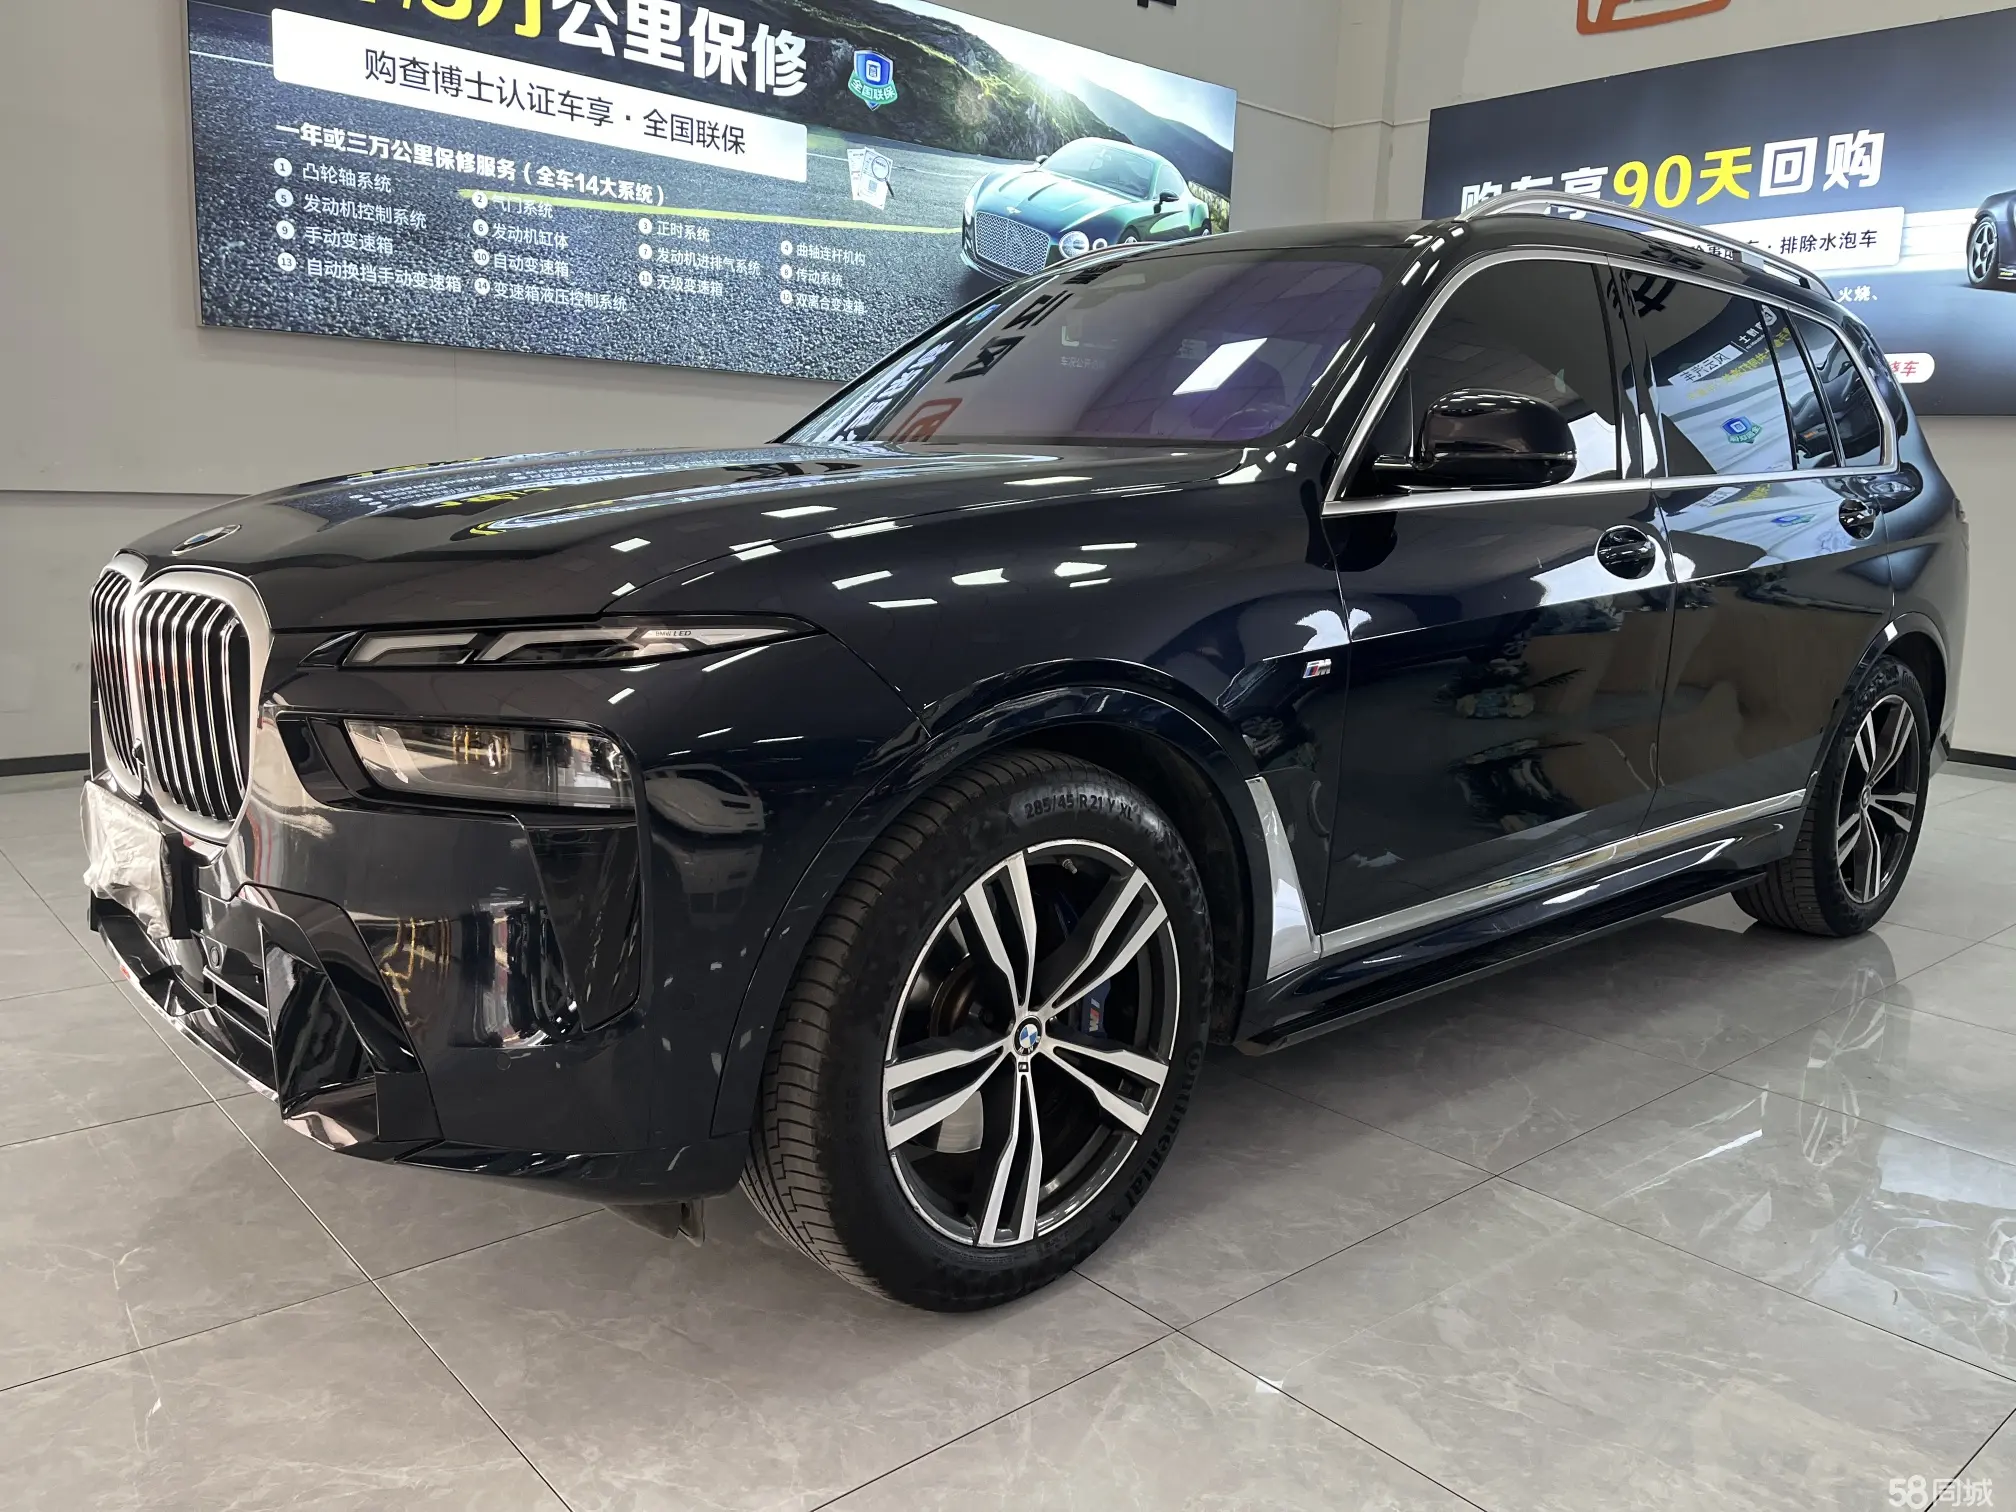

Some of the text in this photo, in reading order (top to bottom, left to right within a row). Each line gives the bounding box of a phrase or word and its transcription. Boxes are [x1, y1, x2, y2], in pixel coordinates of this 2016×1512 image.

[850, 78, 896, 102] 全国联保
[302, 162, 392, 193] 凸轮轴系统
[303, 193, 427, 229] 发动机控制系统
[491, 193, 553, 219] 气门系统
[304, 226, 393, 255] 手动变速箱
[492, 222, 569, 250] 发动机缸体
[656, 220, 710, 243] 正时系统
[493, 253, 569, 278] 自动变速箱
[656, 247, 761, 276] 发动机进排气系统
[796, 243, 866, 266] 曲轴连杆机构
[307, 257, 462, 293] 自动换挡手动变速箱
[656, 274, 724, 297] 无级变速箱
[796, 267, 843, 288] 传动系统
[494, 282, 627, 312] 变速箱液压控制系统
[1024, 794, 1074, 820] 285/45
